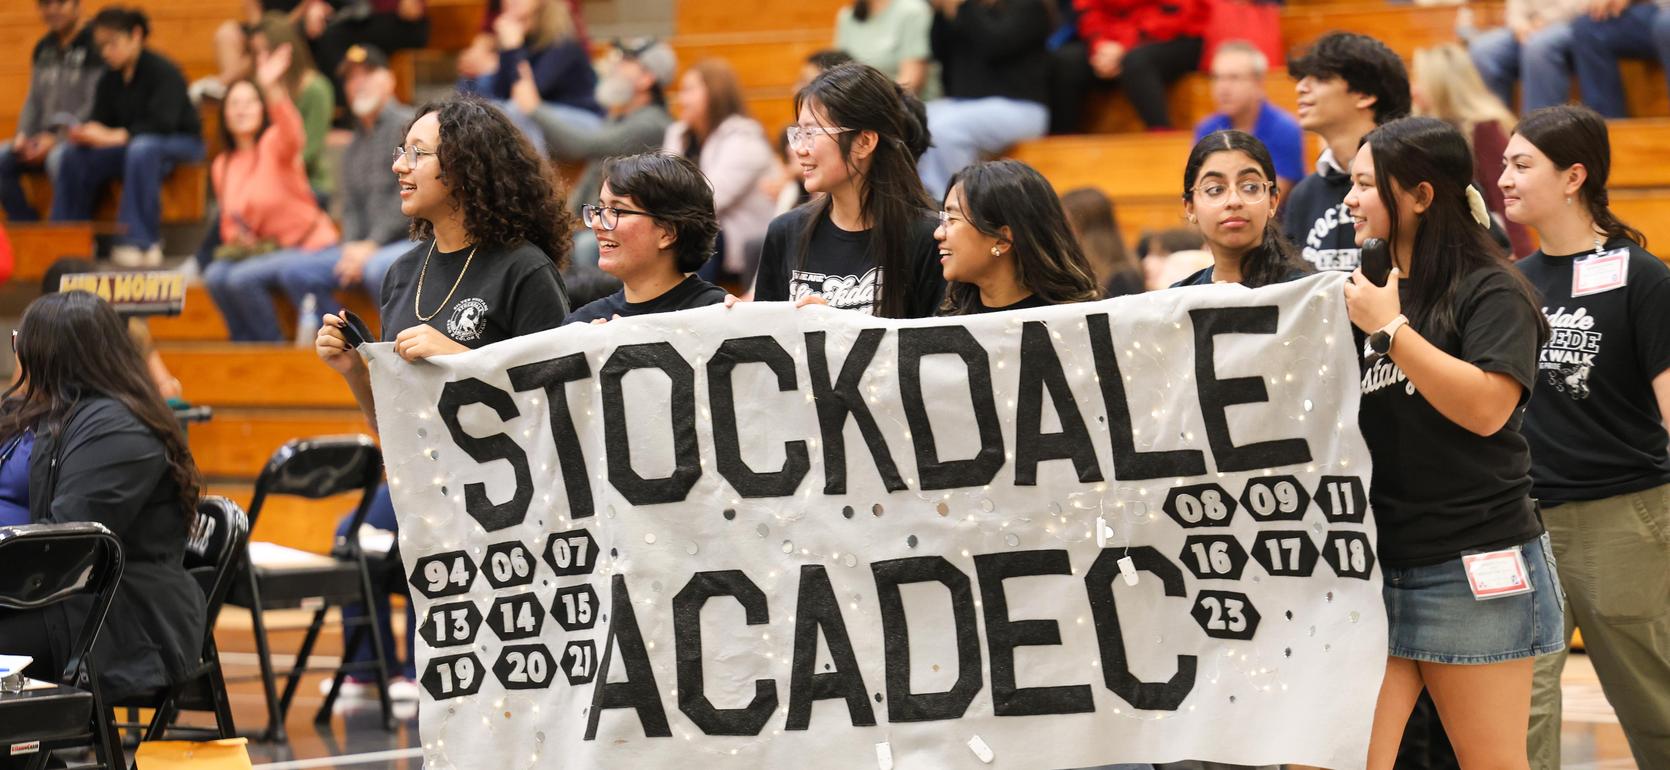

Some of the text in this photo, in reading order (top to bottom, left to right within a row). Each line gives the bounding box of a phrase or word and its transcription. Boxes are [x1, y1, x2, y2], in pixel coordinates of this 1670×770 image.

[114, 272, 183, 303] MONTE
[437, 306, 1312, 531] STOCKDALE
[1175, 481, 1355, 523] 08 09 11
[424, 536, 589, 592] 94 06 07
[1190, 537, 1366, 574] 16 17 18
[432, 592, 591, 641] 13 14 15
[1201, 596, 1247, 632] 23
[583, 547, 1198, 741] ACADEC
[436, 645, 592, 693] 19 20 21
